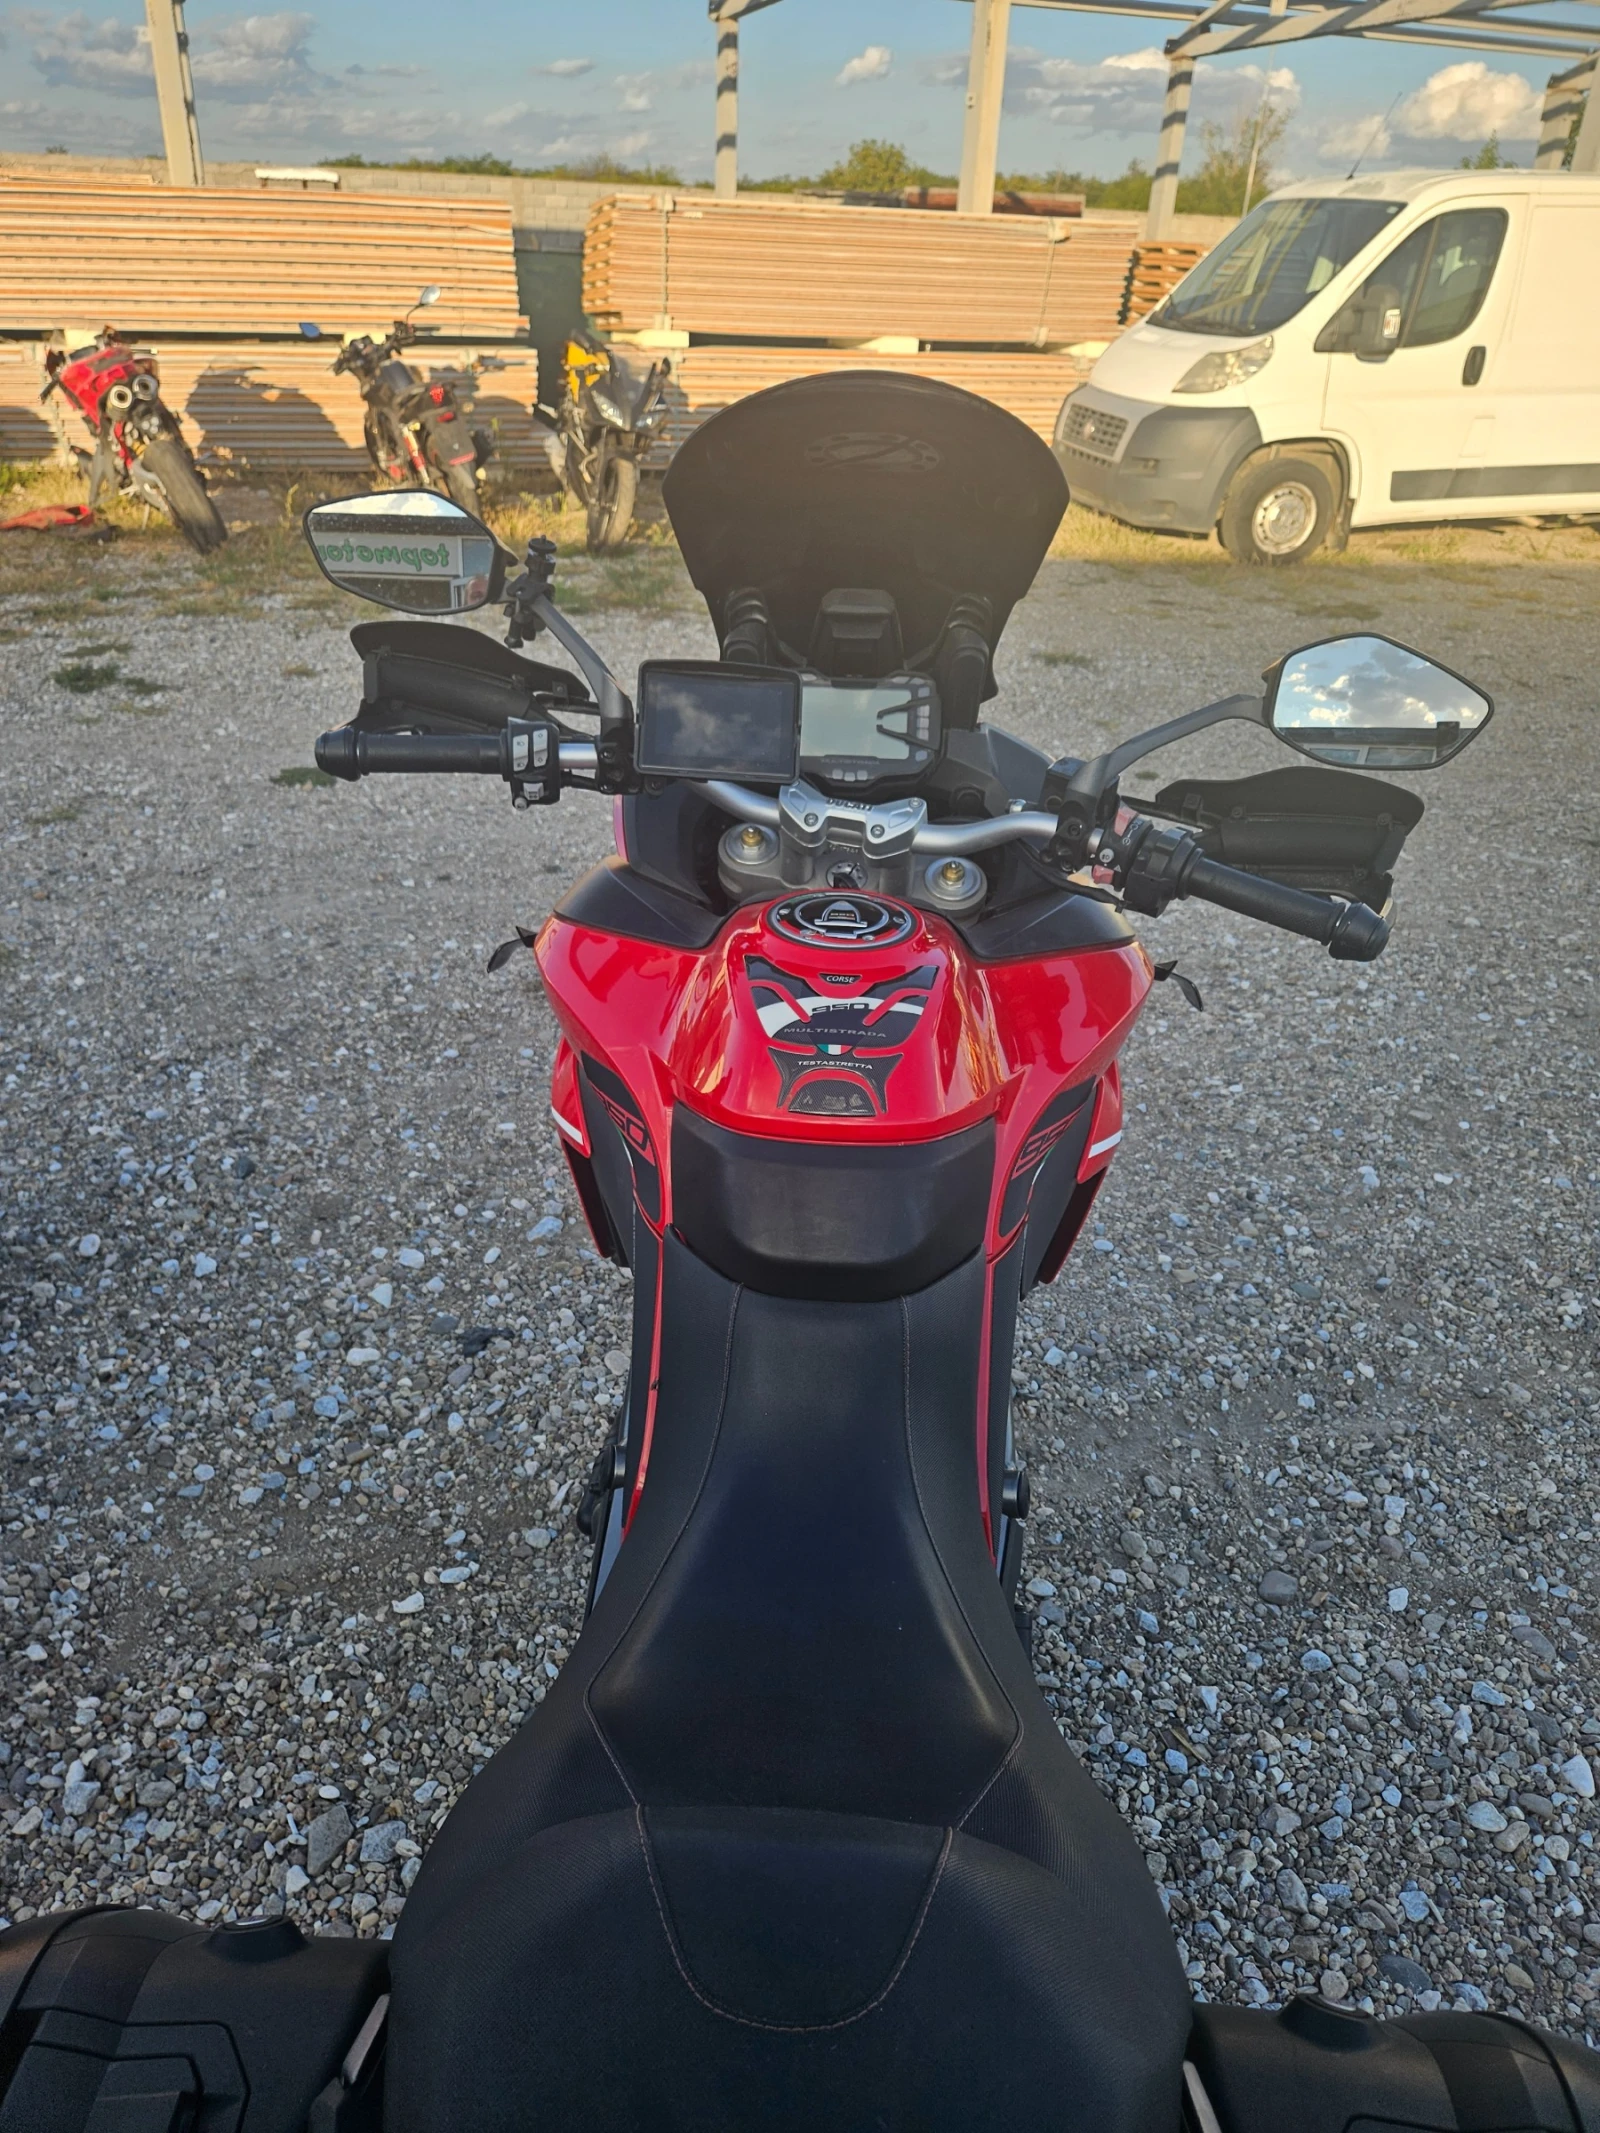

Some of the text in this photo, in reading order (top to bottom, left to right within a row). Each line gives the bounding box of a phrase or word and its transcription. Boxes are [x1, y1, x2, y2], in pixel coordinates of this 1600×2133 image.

[826, 975, 855, 983] CORSE
[811, 1003, 869, 1014] 950
[784, 1028, 887, 1038] MULTISTRADA
[797, 1060, 873, 1069] TESTASTRETTA
